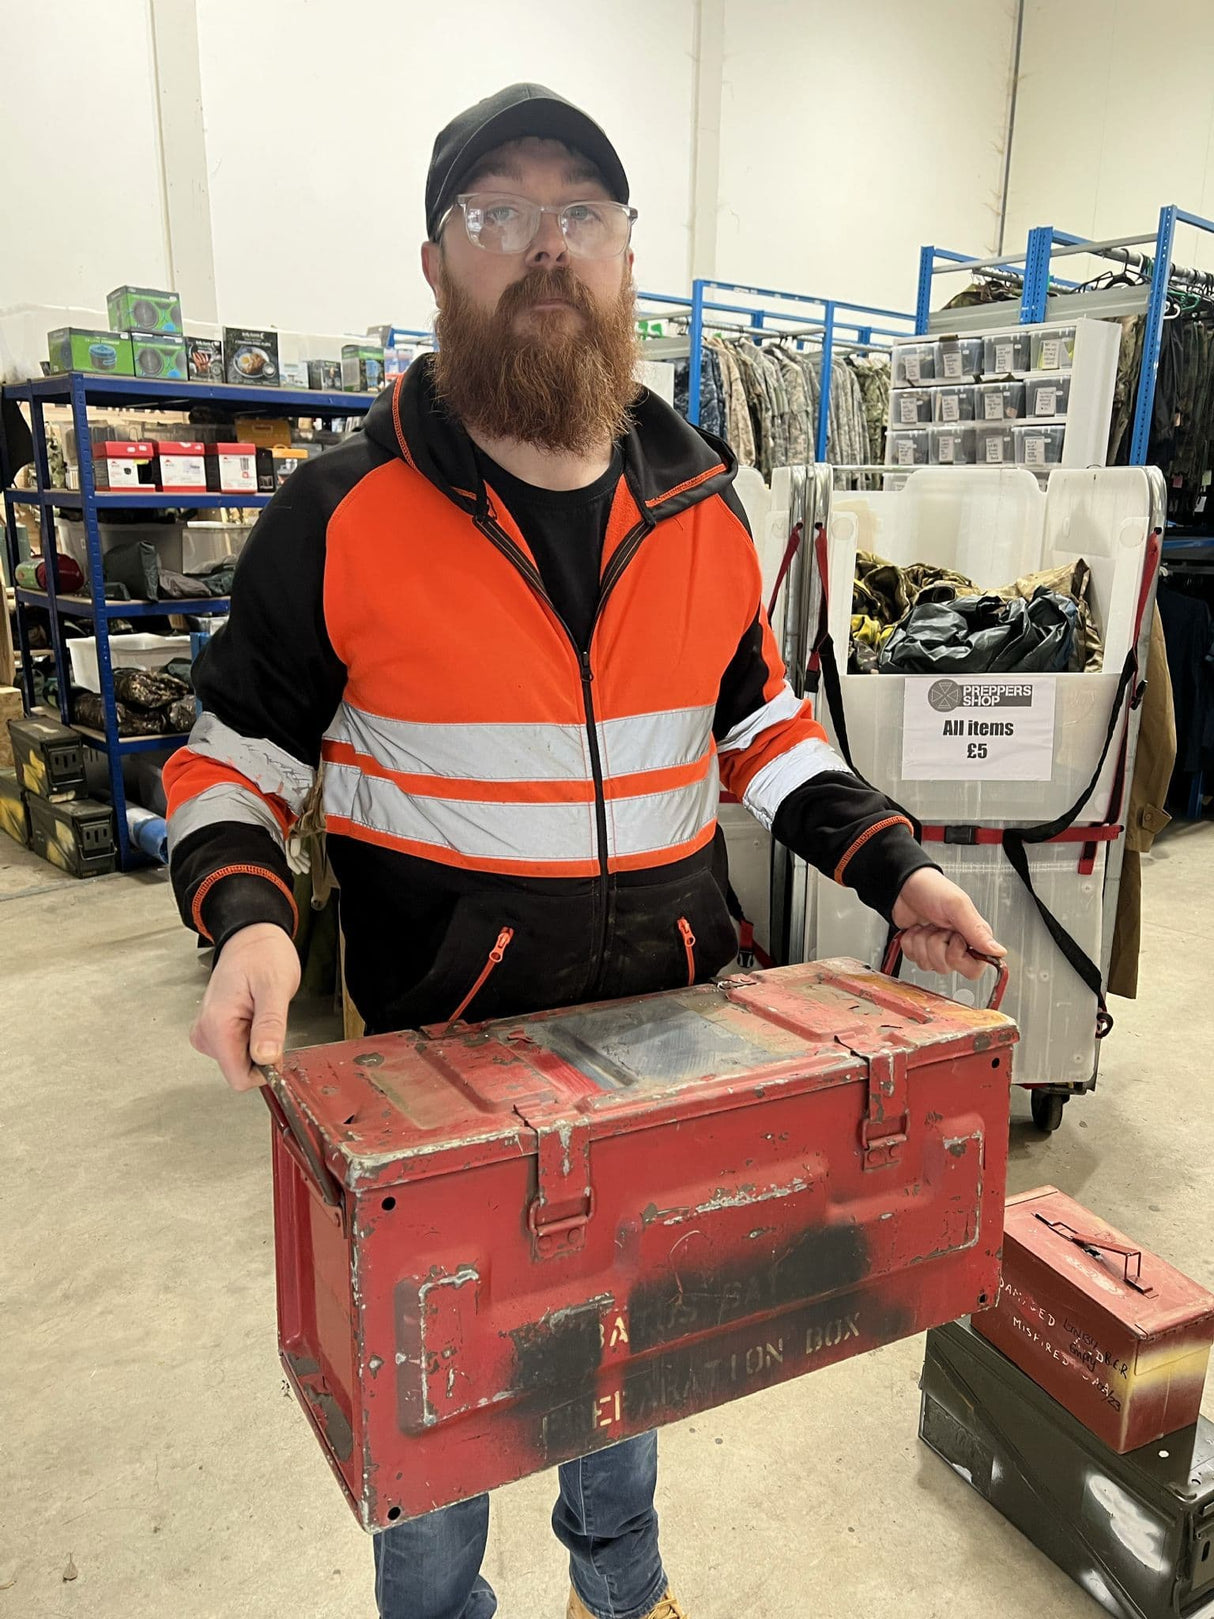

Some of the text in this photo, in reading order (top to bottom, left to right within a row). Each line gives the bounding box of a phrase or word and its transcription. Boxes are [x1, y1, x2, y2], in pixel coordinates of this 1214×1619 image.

[962, 685, 1032, 696] PREPPERS
[962, 695, 1000, 706] SHOP
[943, 719, 1014, 736] All items
[966, 742, 988, 759] £5
[999, 1277, 1056, 1326] DAMGED
